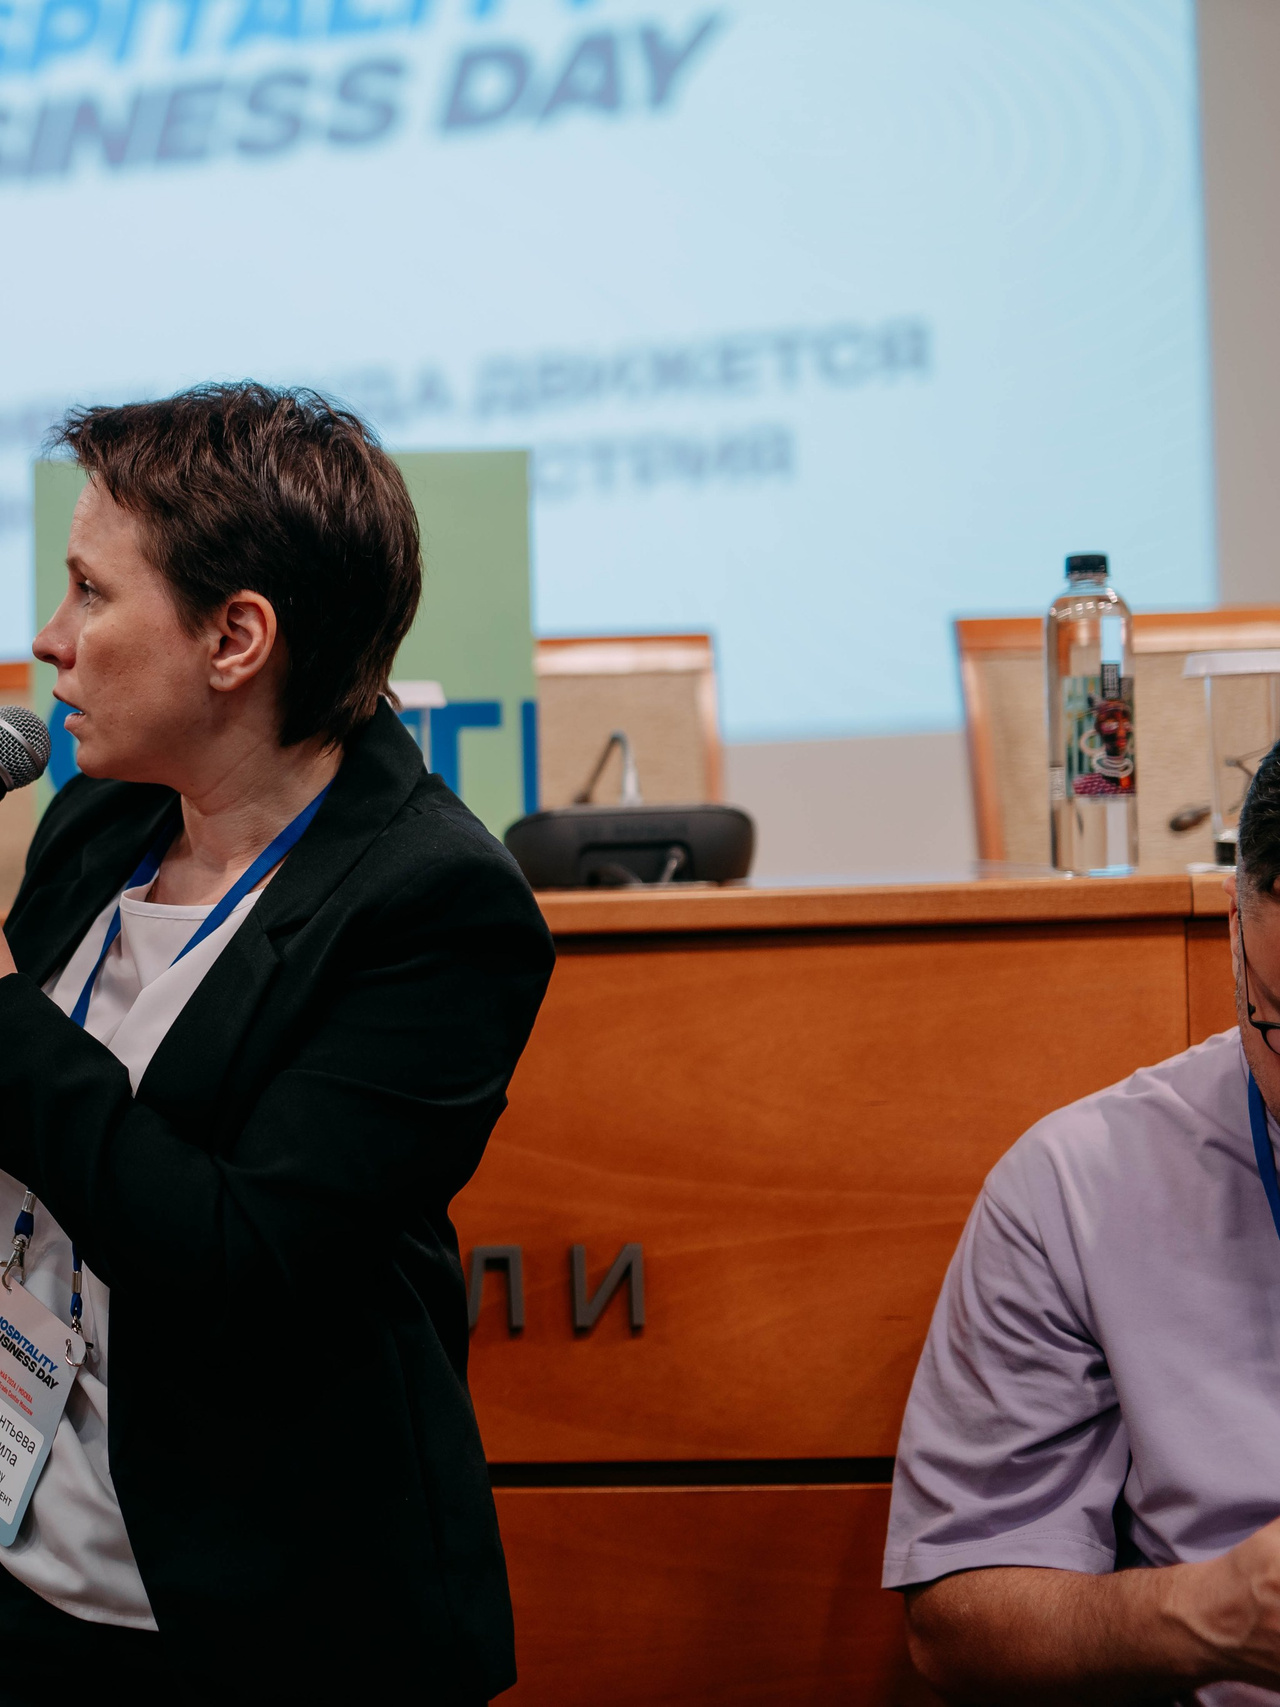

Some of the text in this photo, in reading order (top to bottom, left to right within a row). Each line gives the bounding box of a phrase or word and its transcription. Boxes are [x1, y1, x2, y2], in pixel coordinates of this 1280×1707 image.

[437, 12, 718, 130] DAY
[35, 1368, 59, 1390] DAY
[8, 1390, 20, 1404] Center
[19, 1400, 34, 1416] Moscow
